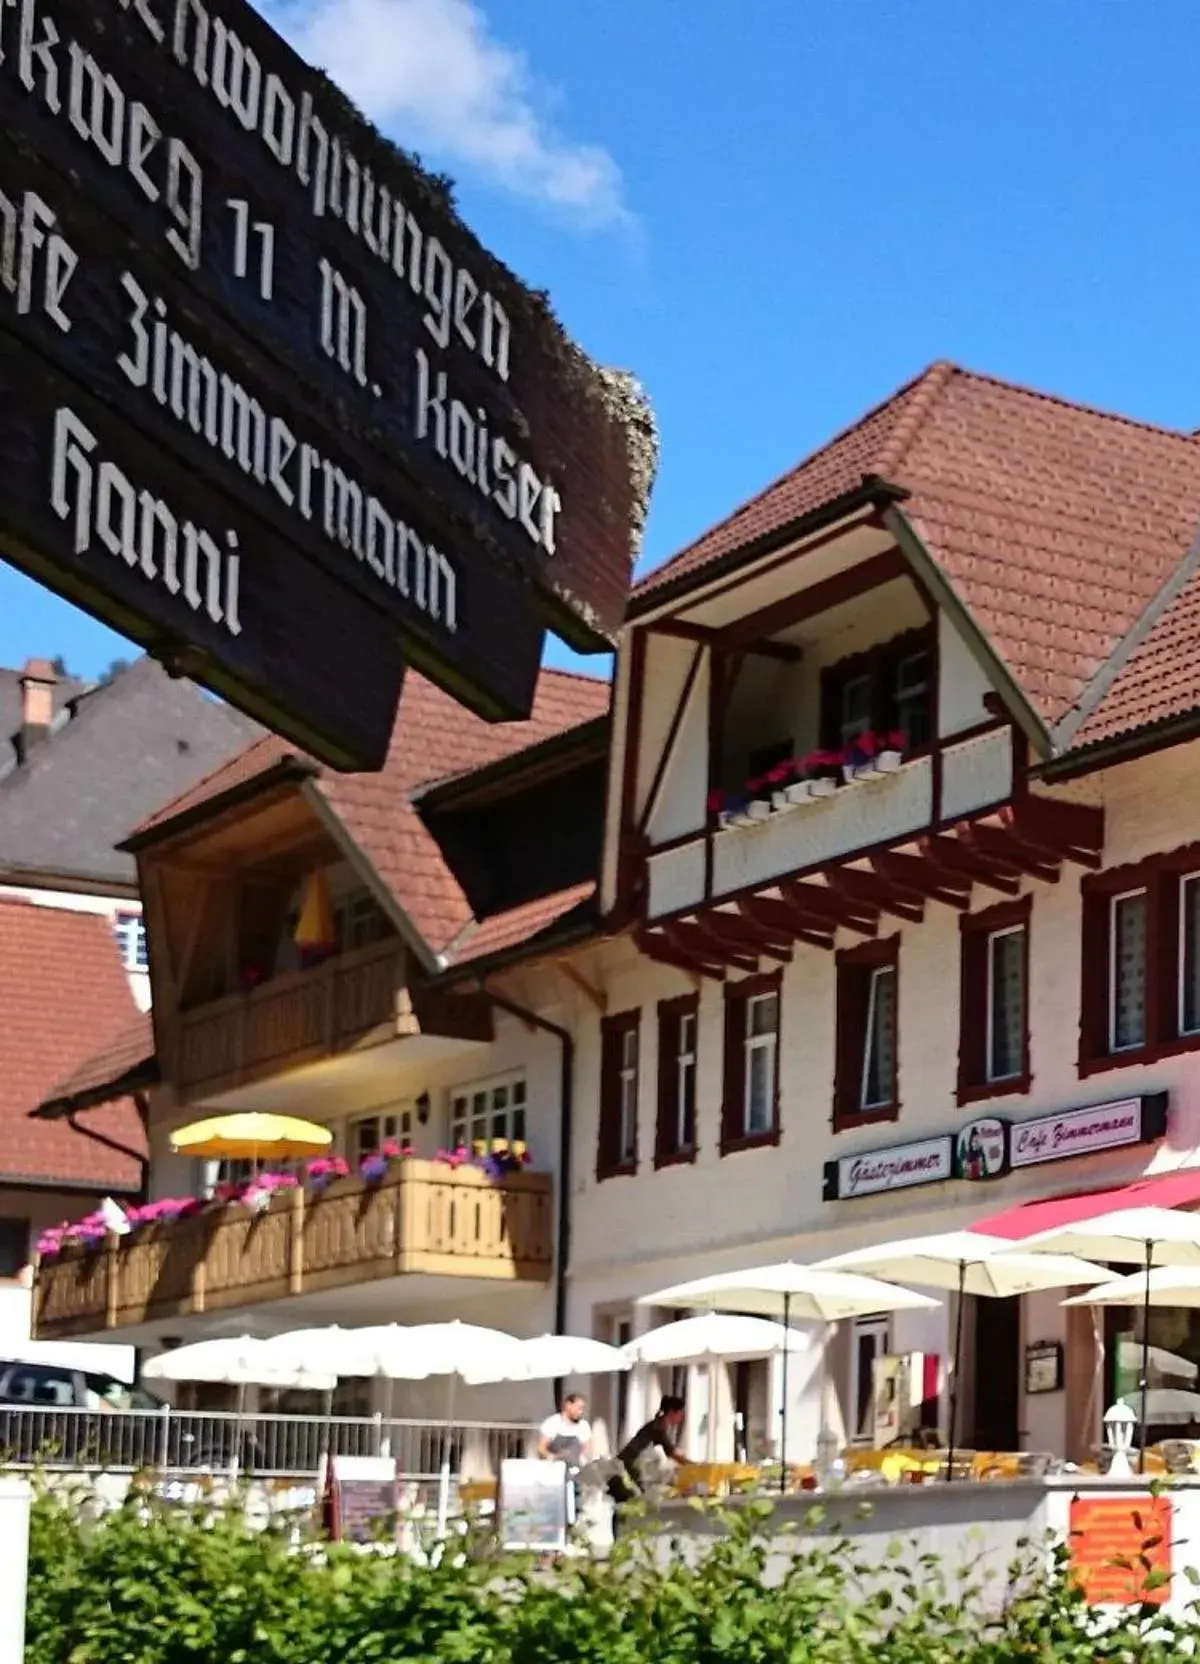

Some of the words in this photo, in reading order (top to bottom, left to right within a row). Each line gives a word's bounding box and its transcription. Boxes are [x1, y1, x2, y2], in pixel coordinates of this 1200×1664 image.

[0, 0, 203, 271] kweg
[416, 347, 562, 556] Kaiser
[118, 271, 457, 634] Zimmermann
[1052, 1116, 1135, 1148] Zimmermann
